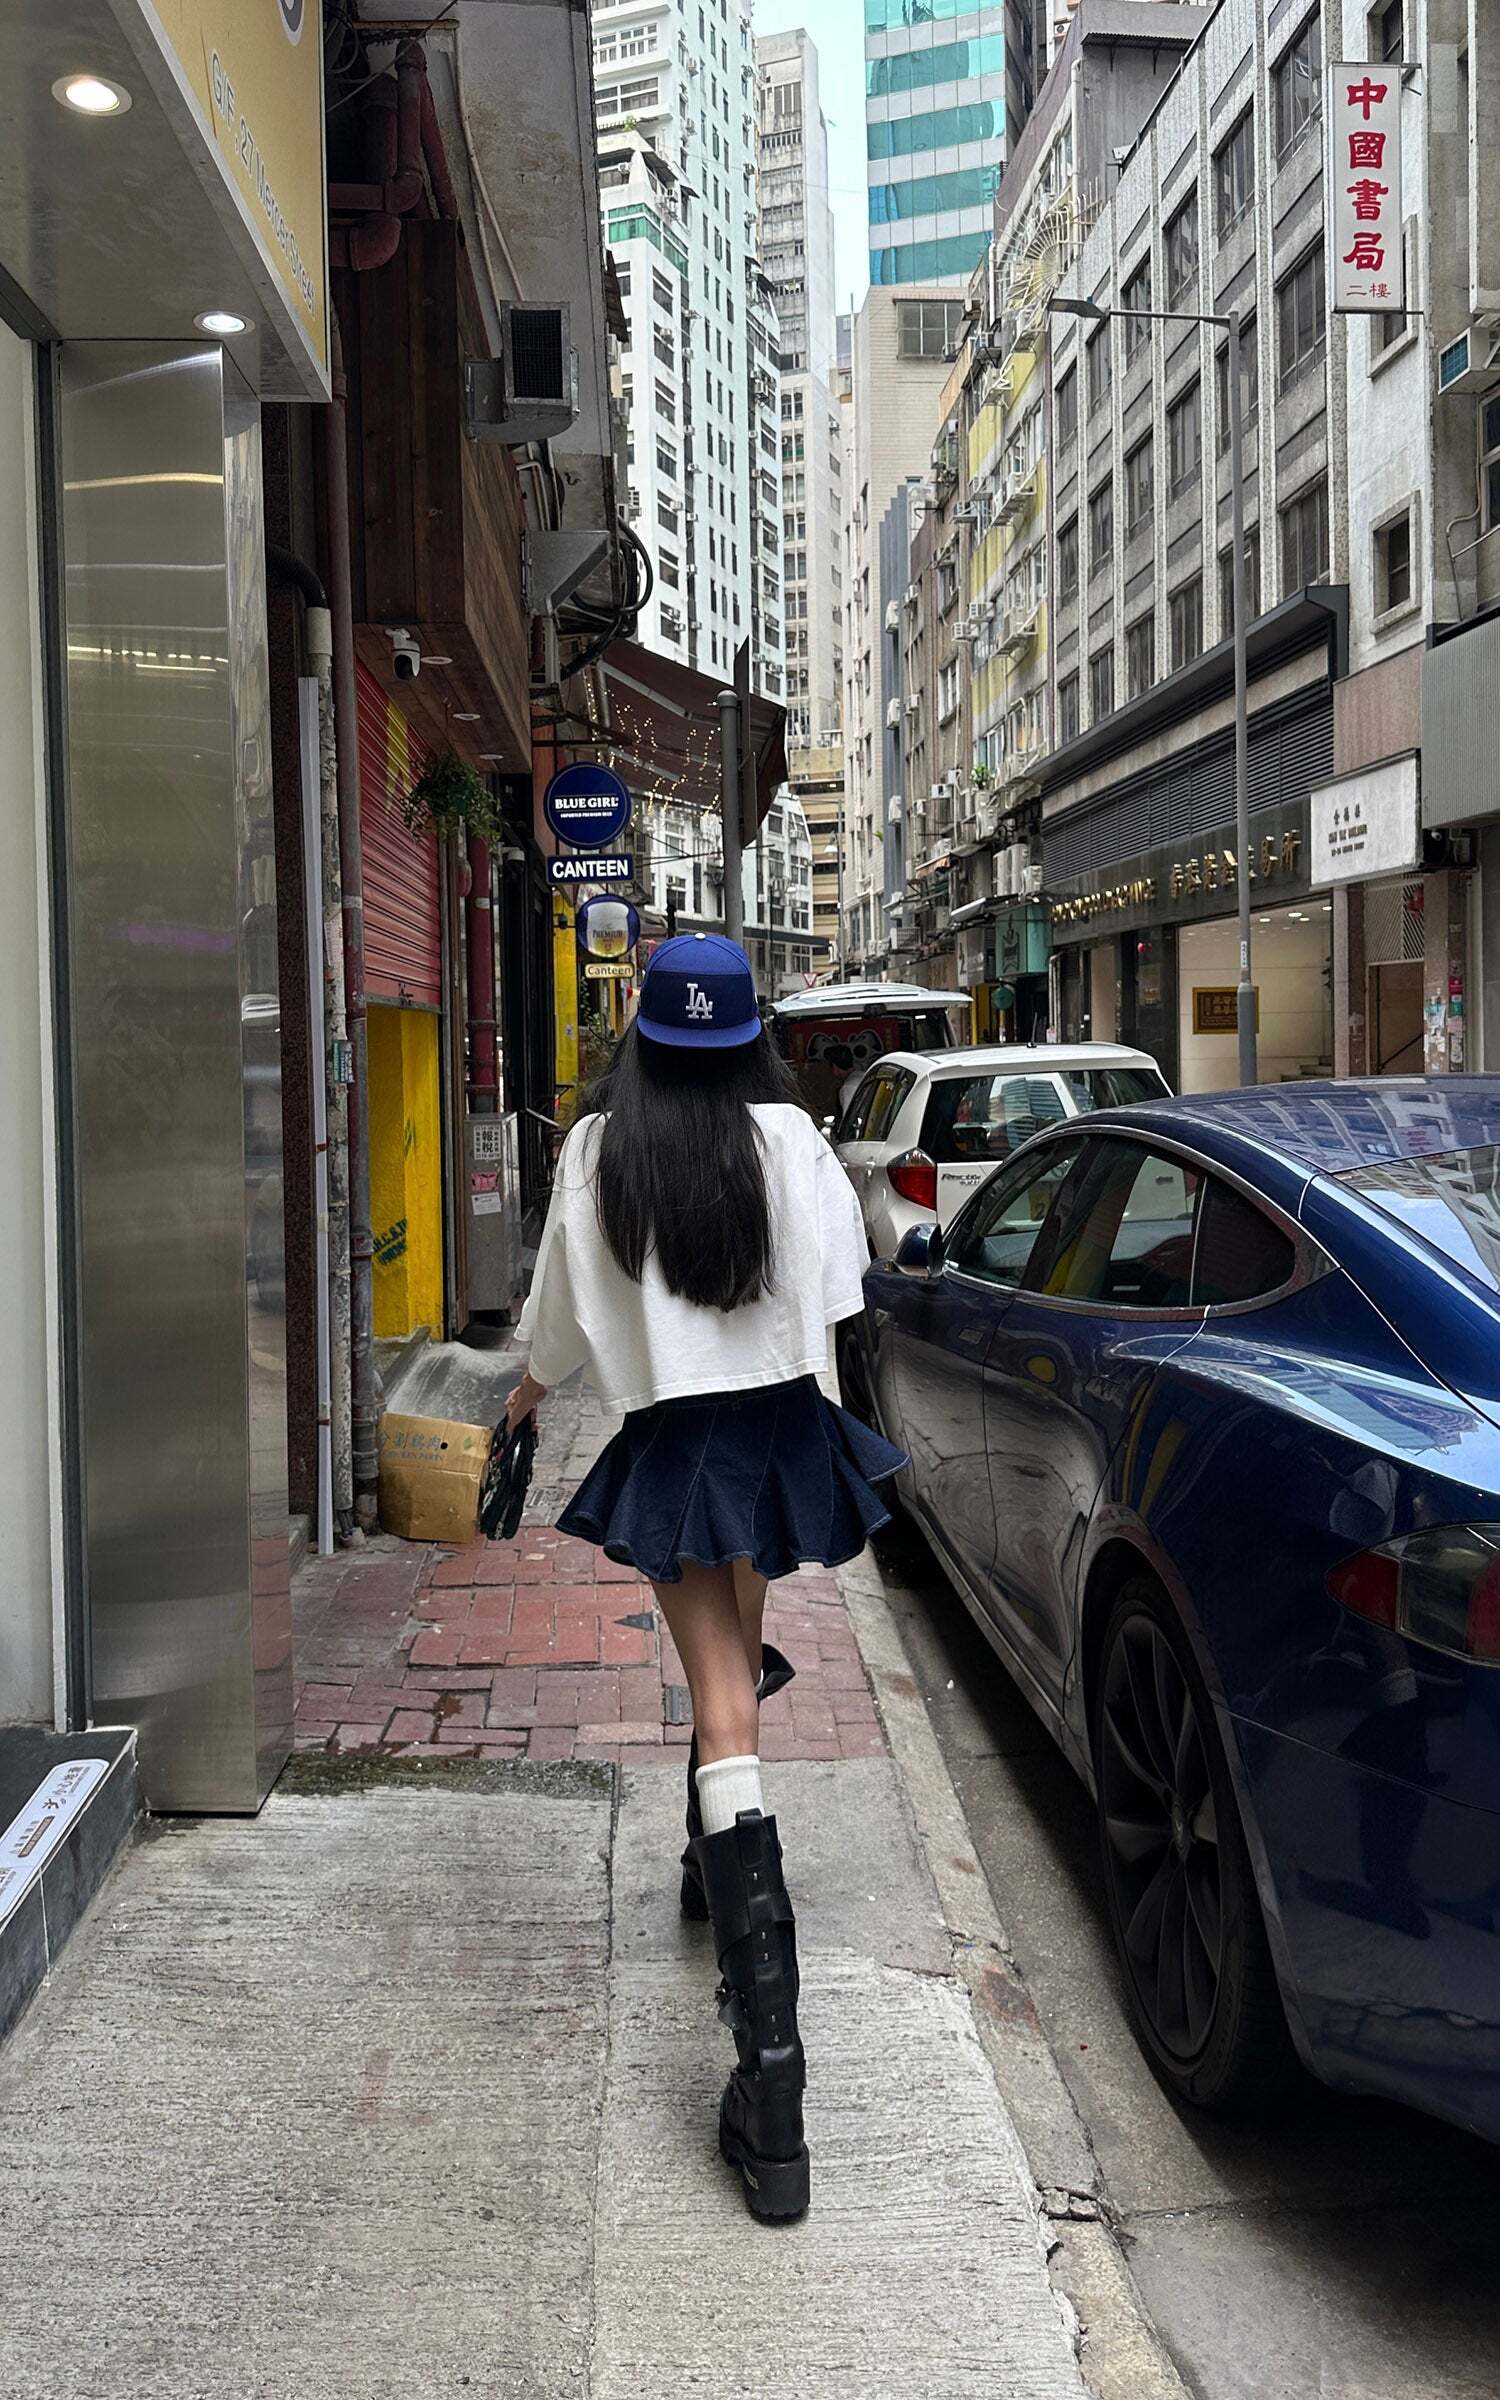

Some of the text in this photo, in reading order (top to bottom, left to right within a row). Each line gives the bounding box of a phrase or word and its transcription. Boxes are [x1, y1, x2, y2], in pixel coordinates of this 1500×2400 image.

[1343, 76, 1389, 271] 中國書局
[240, 116, 254, 176] 27
[255, 150, 289, 258] Mercer
[289, 230, 316, 320] Street
[1346, 282, 1391, 298] 二樓
[554, 796, 619, 810] BLUE GIRL
[552, 860, 629, 878] CANTEEN
[587, 965, 631, 977] Canteen
[685, 982, 713, 1020] LA
